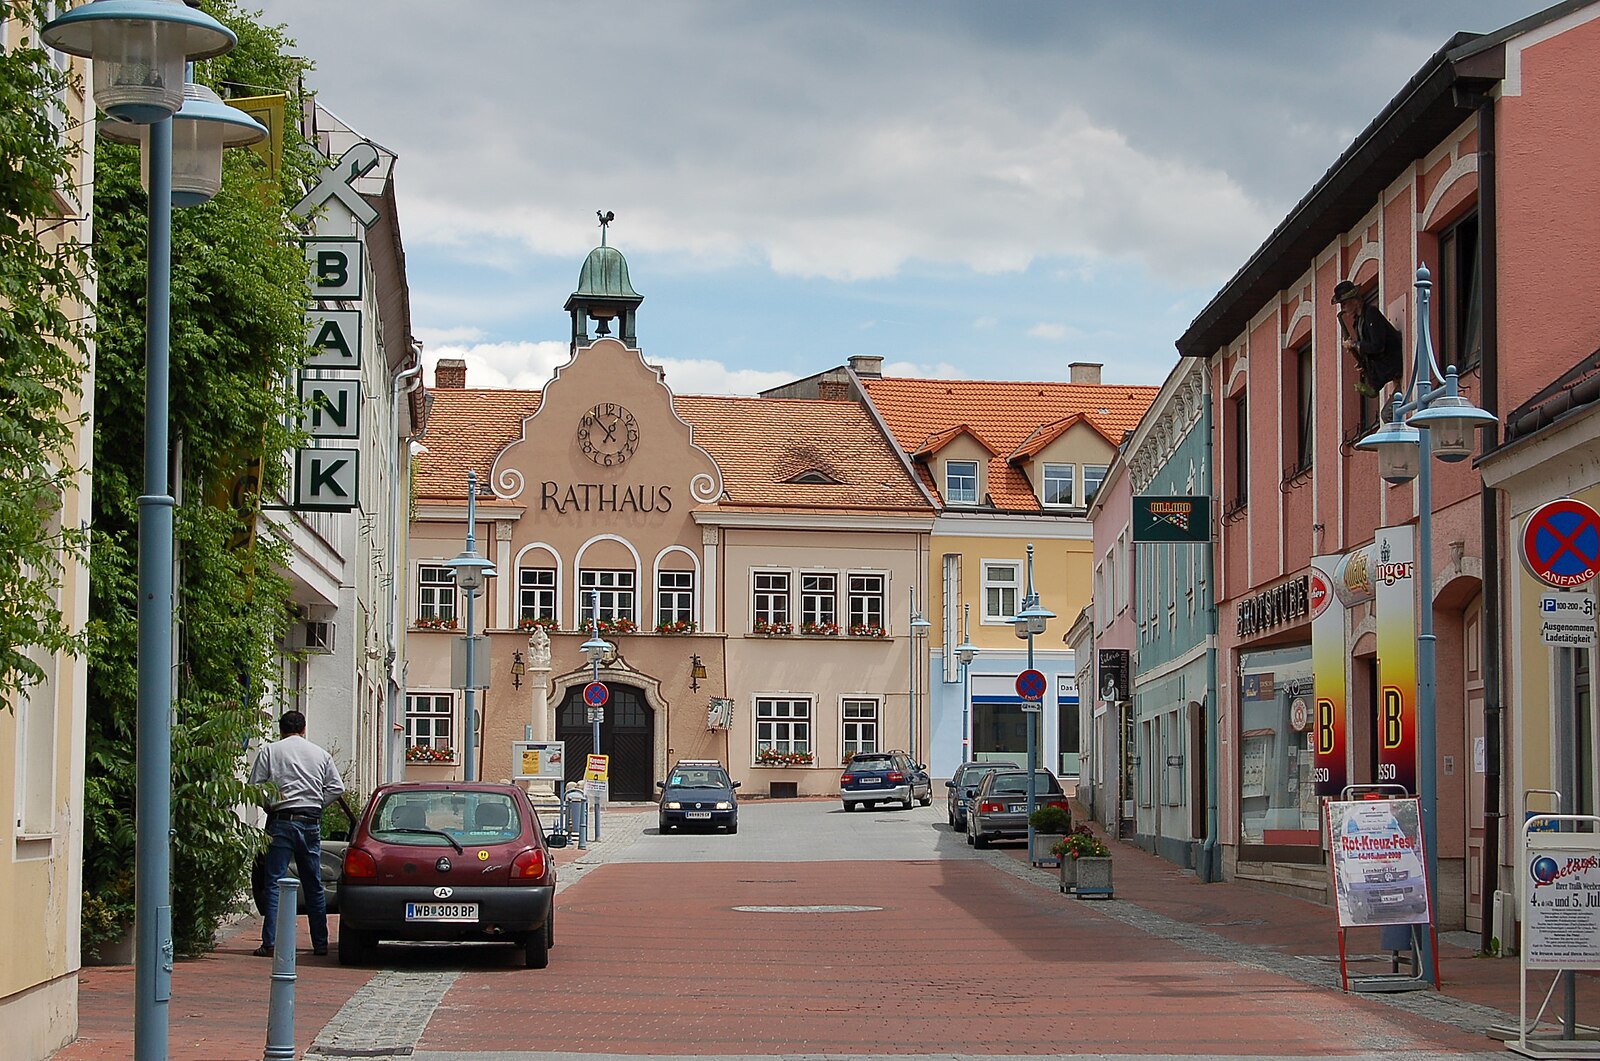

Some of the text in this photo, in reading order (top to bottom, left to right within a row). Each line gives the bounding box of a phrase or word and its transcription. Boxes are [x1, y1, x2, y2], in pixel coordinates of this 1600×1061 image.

[311, 250, 353, 496] BANK
[594, 405, 600, 418] 11
[605, 403, 615, 416] 12
[582, 415, 593, 427] 10
[625, 413, 634, 426] 2
[579, 429, 588, 440] 9
[627, 429, 638, 442] 3
[582, 441, 592, 453] 8
[624, 442, 634, 456] 4
[592, 451, 600, 463] 7
[604, 454, 612, 466] 6
[617, 451, 626, 464] 5
[541, 481, 672, 514] RATHAUS
[1151, 502, 1191, 512] BILLARD
[1541, 568, 1595, 585] ANFANG
[1237, 575, 1308, 637] BROTSTUBE
[1545, 600, 1555, 611] P
[1557, 602, 1578, 610] 100-200
[1543, 622, 1595, 632] Ausgenommen
[1545, 633, 1591, 645] Ladetätigkeit
[1383, 686, 1404, 749] B
[1317, 698, 1335, 755] B
[1342, 834, 1415, 851] Rot-Kreuz-Fest
[439, 888, 448, 897] A
[1530, 892, 1541, 907] 4.
[1555, 896, 1569, 907] und
[1572, 893, 1582, 907] 5.
[415, 905, 475, 917] WB 303 BP
